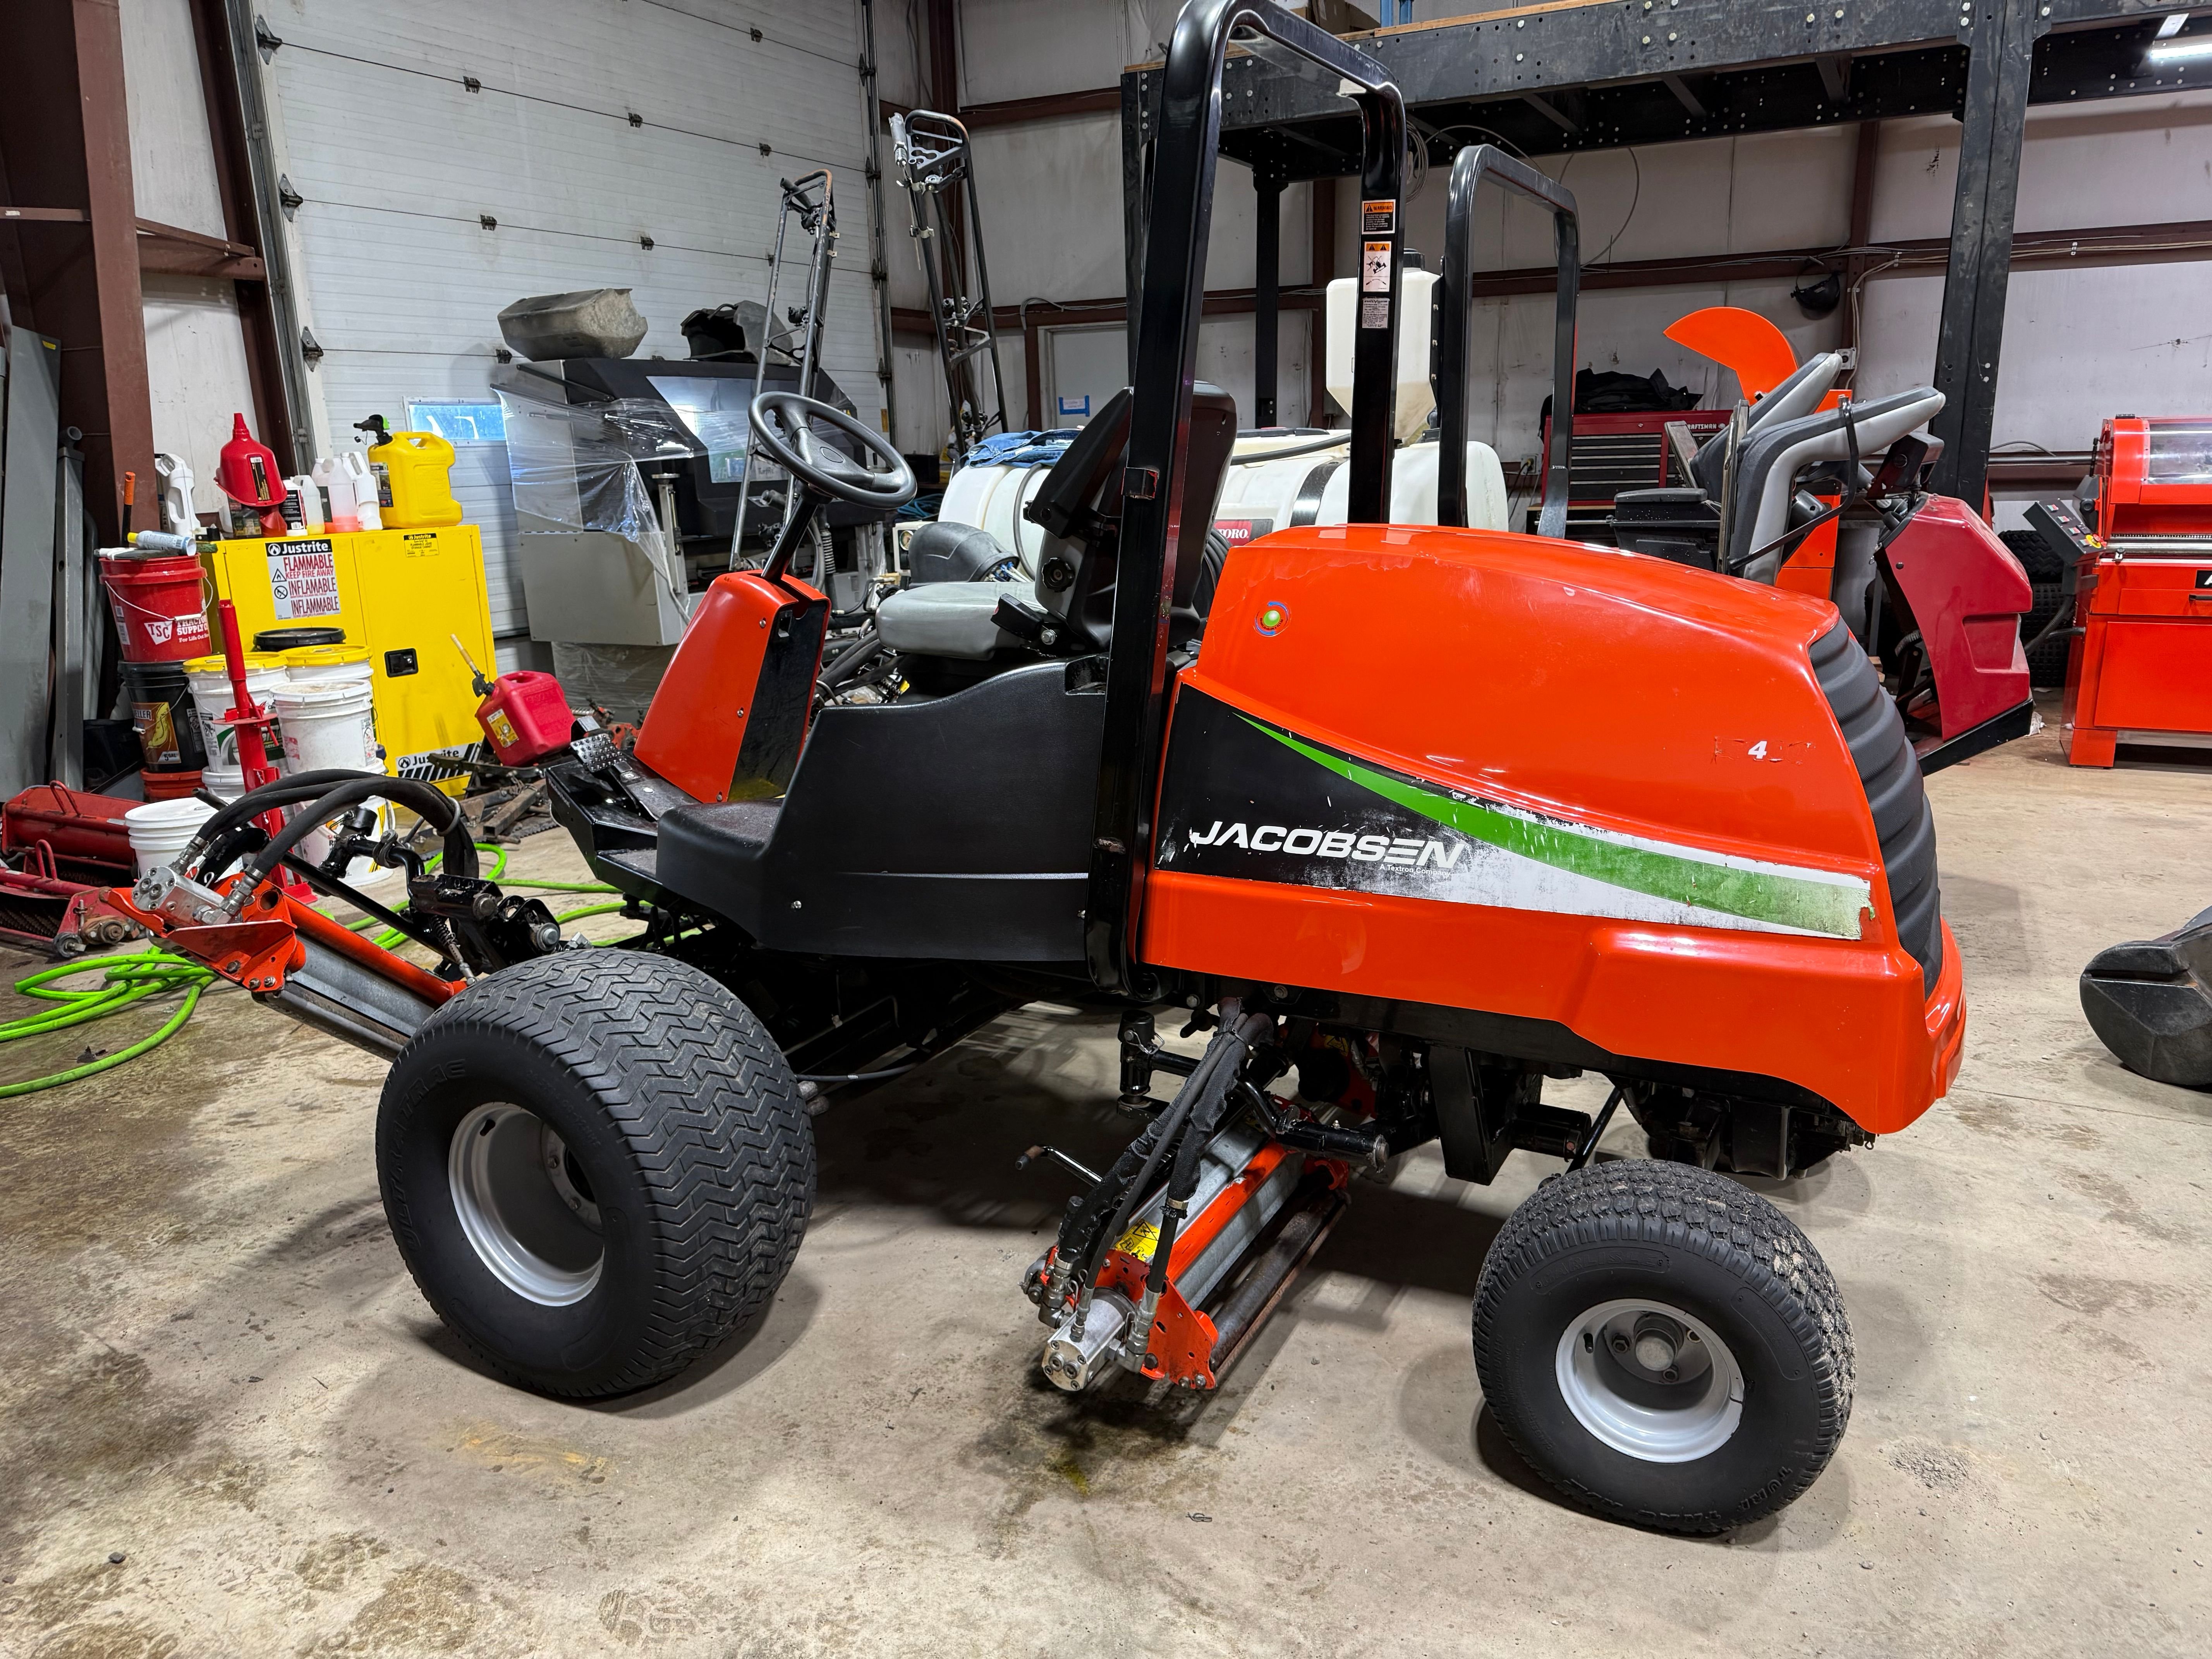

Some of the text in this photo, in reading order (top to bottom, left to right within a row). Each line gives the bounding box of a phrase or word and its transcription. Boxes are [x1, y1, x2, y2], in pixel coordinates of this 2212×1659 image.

[282, 541, 328, 554] Justrite
[283, 554, 333, 572] FLAMMABLE
[302, 570, 315, 578] FIRE
[317, 568, 334, 577] AWAY
[288, 577, 337, 596] INFLAMABLE
[291, 596, 339, 615] INFLAMMABLE
[148, 624, 170, 639] TSC
[177, 623, 204, 635] SUPPLY
[413, 750, 459, 766] Juite
[1190, 821, 1465, 869] JACOBSEN
[1387, 864, 1414, 873] Textron
[1416, 867, 1451, 877] Company
